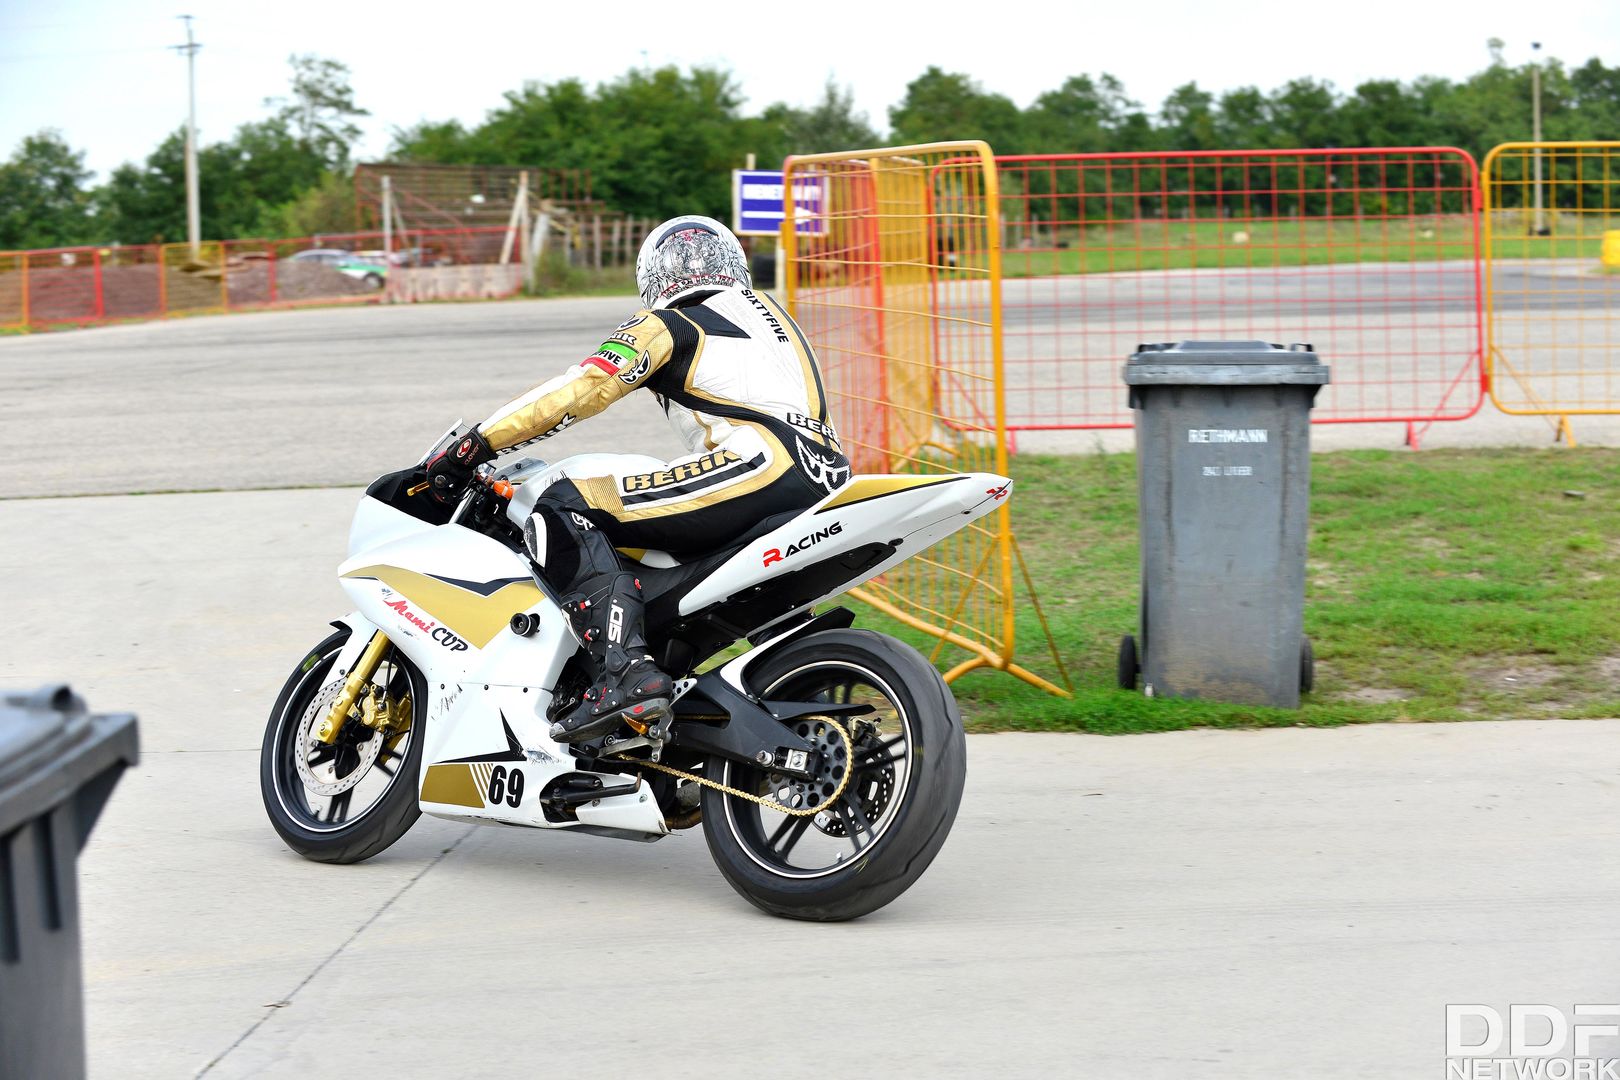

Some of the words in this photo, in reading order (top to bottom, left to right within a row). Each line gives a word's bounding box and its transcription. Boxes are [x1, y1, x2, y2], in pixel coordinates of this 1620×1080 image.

[741, 289, 789, 342] SIXTYFIVE
[762, 521, 843, 568] RACING
[383, 600, 435, 634] Mami
[431, 627, 469, 652] CUP
[488, 765, 525, 808] 69
